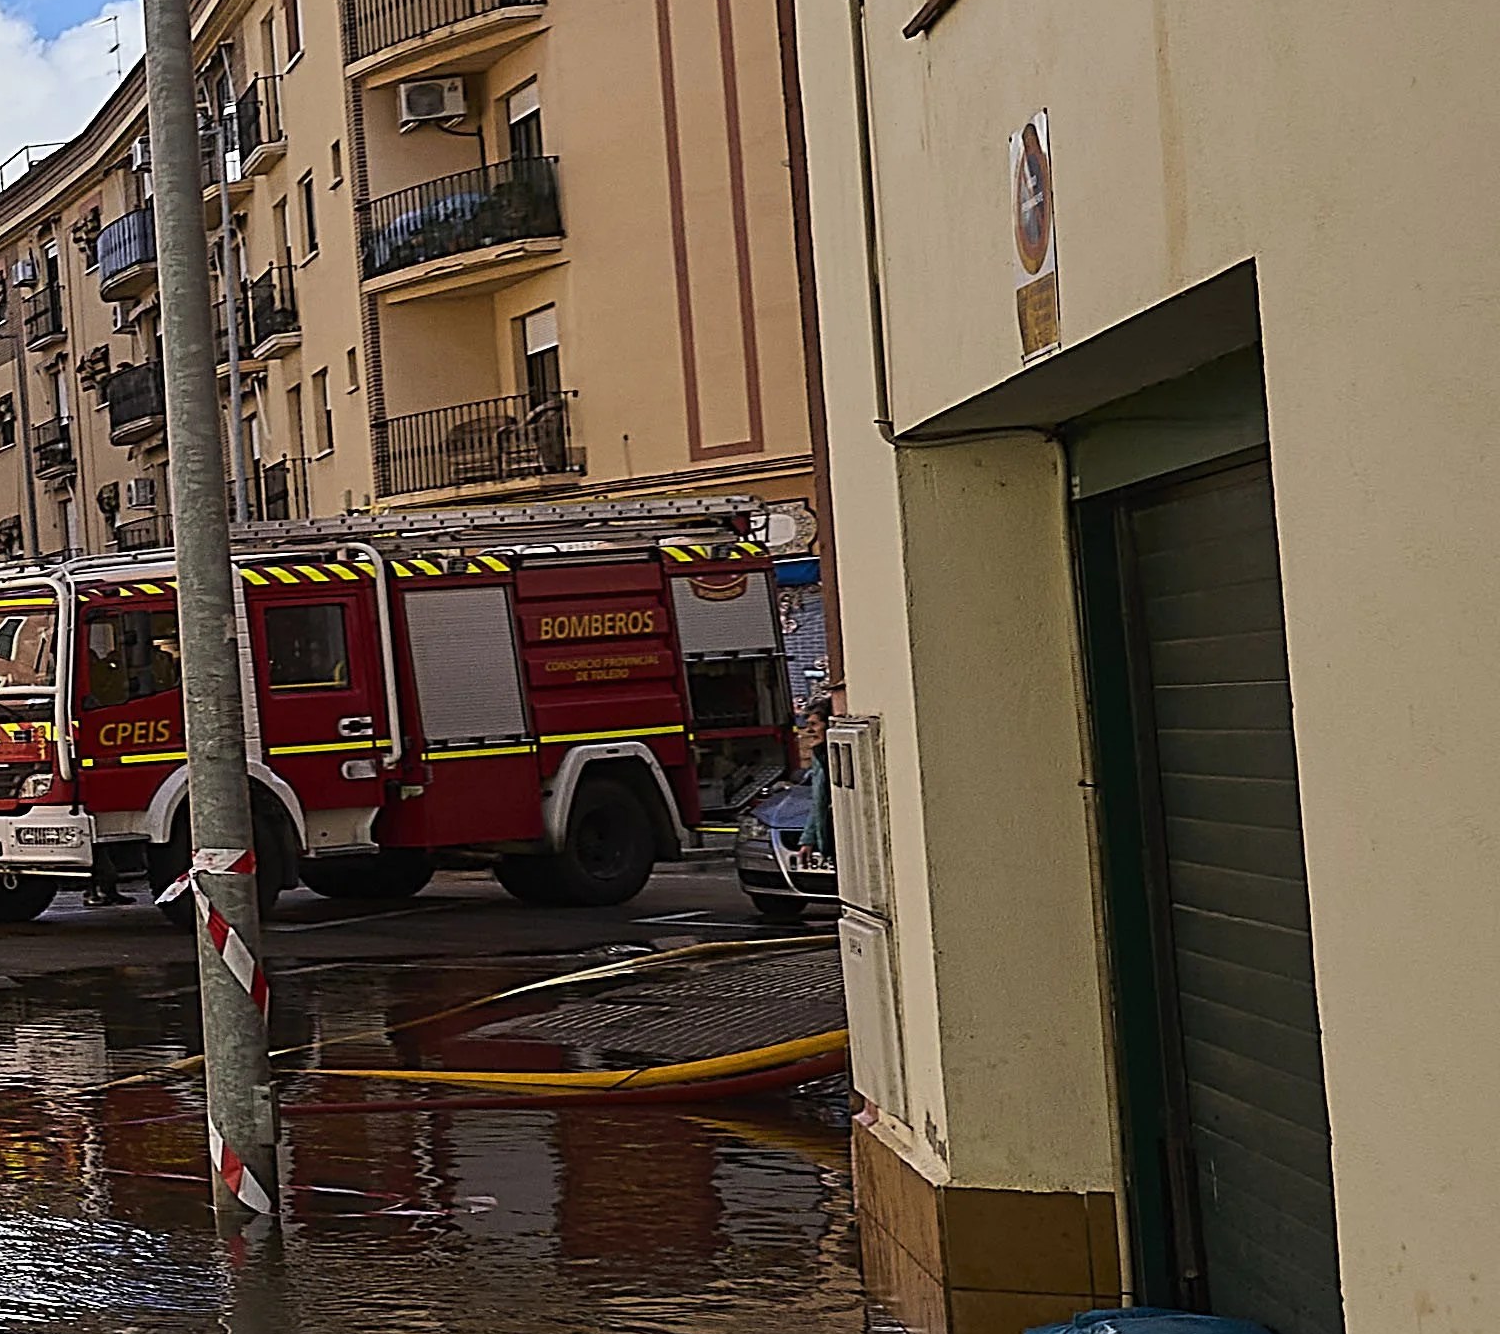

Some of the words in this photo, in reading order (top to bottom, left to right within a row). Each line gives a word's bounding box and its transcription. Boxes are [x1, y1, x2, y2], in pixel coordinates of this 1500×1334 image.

[540, 611, 654, 641] BOMBEROS
[591, 668, 630, 680] TOLEDO
[99, 720, 170, 746] CPEIS
